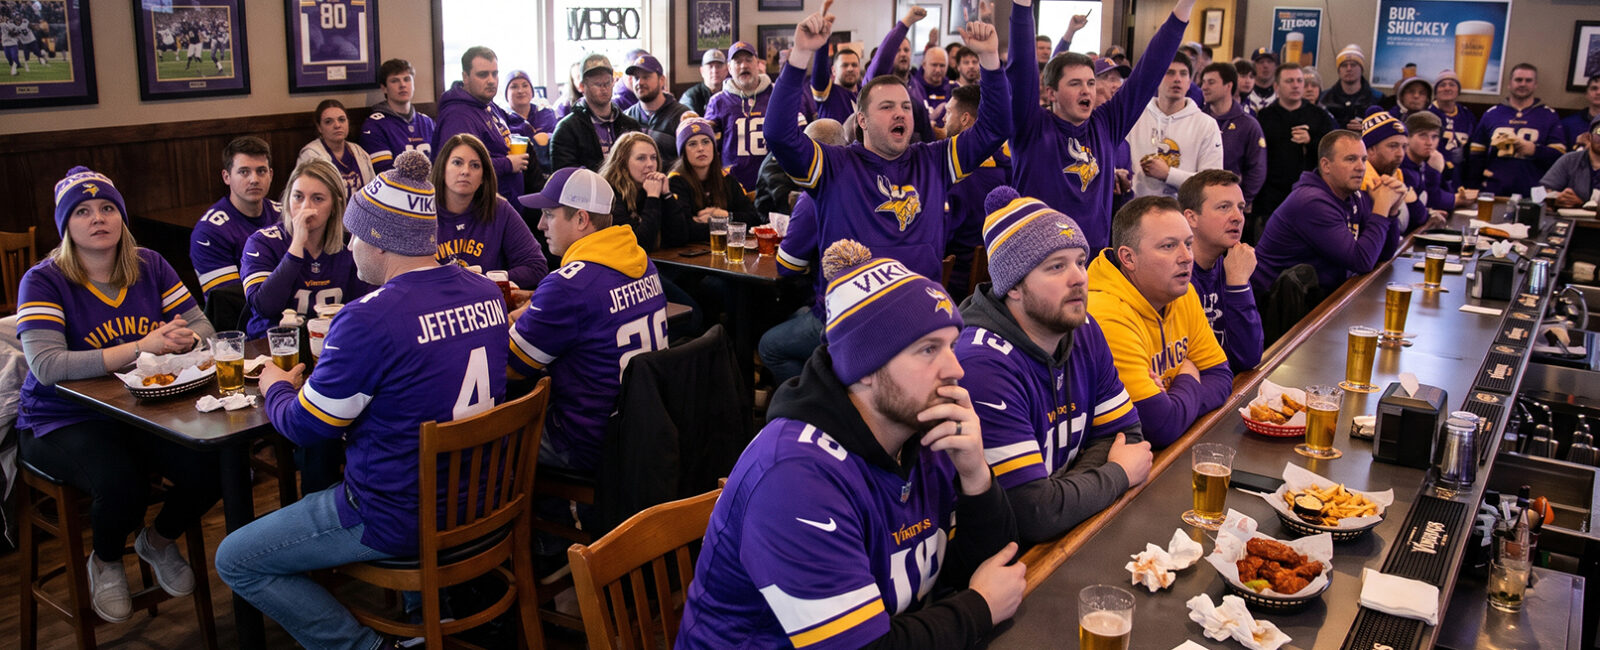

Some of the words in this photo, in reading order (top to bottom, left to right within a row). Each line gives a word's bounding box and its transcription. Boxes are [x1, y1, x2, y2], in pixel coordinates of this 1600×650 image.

[320, 3, 347, 29] 80
[1387, 21, 1449, 36] SHUCKEY
[407, 194, 436, 212] VIK
[200, 208, 230, 226] 16
[417, 299, 506, 344] JEFFERSON
[452, 346, 495, 421] 4
